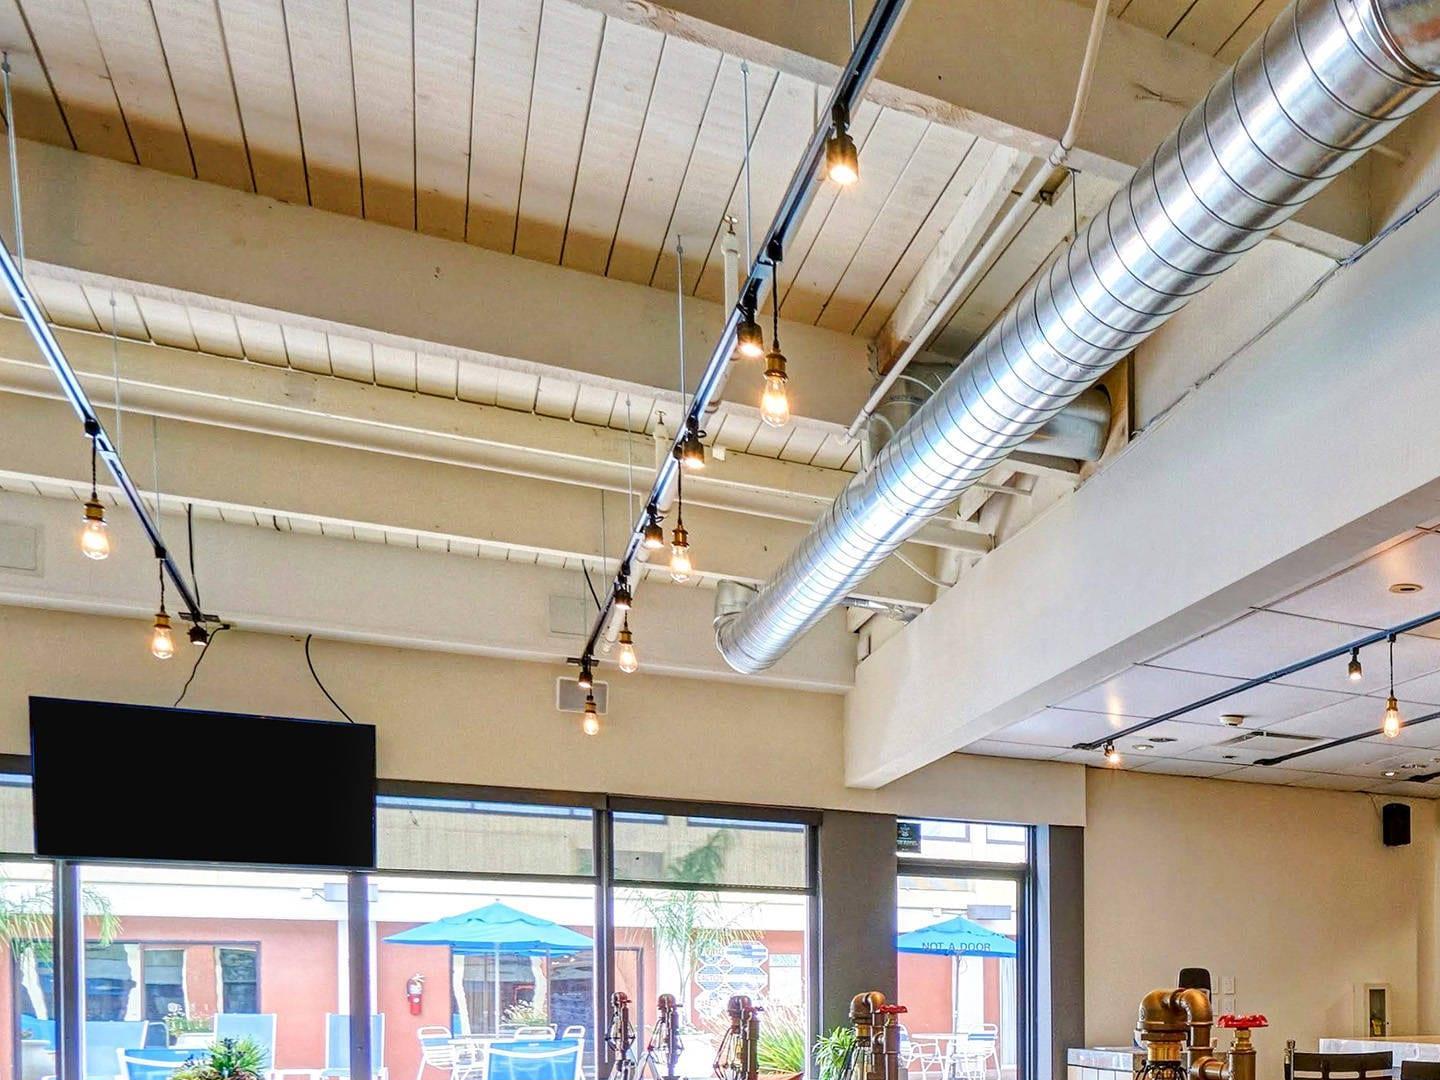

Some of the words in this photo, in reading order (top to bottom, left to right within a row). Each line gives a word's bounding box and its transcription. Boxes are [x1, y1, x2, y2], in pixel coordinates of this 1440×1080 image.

[922, 942, 944, 950] NOT
[948, 942, 957, 951] A
[960, 943, 991, 952] DOOR
